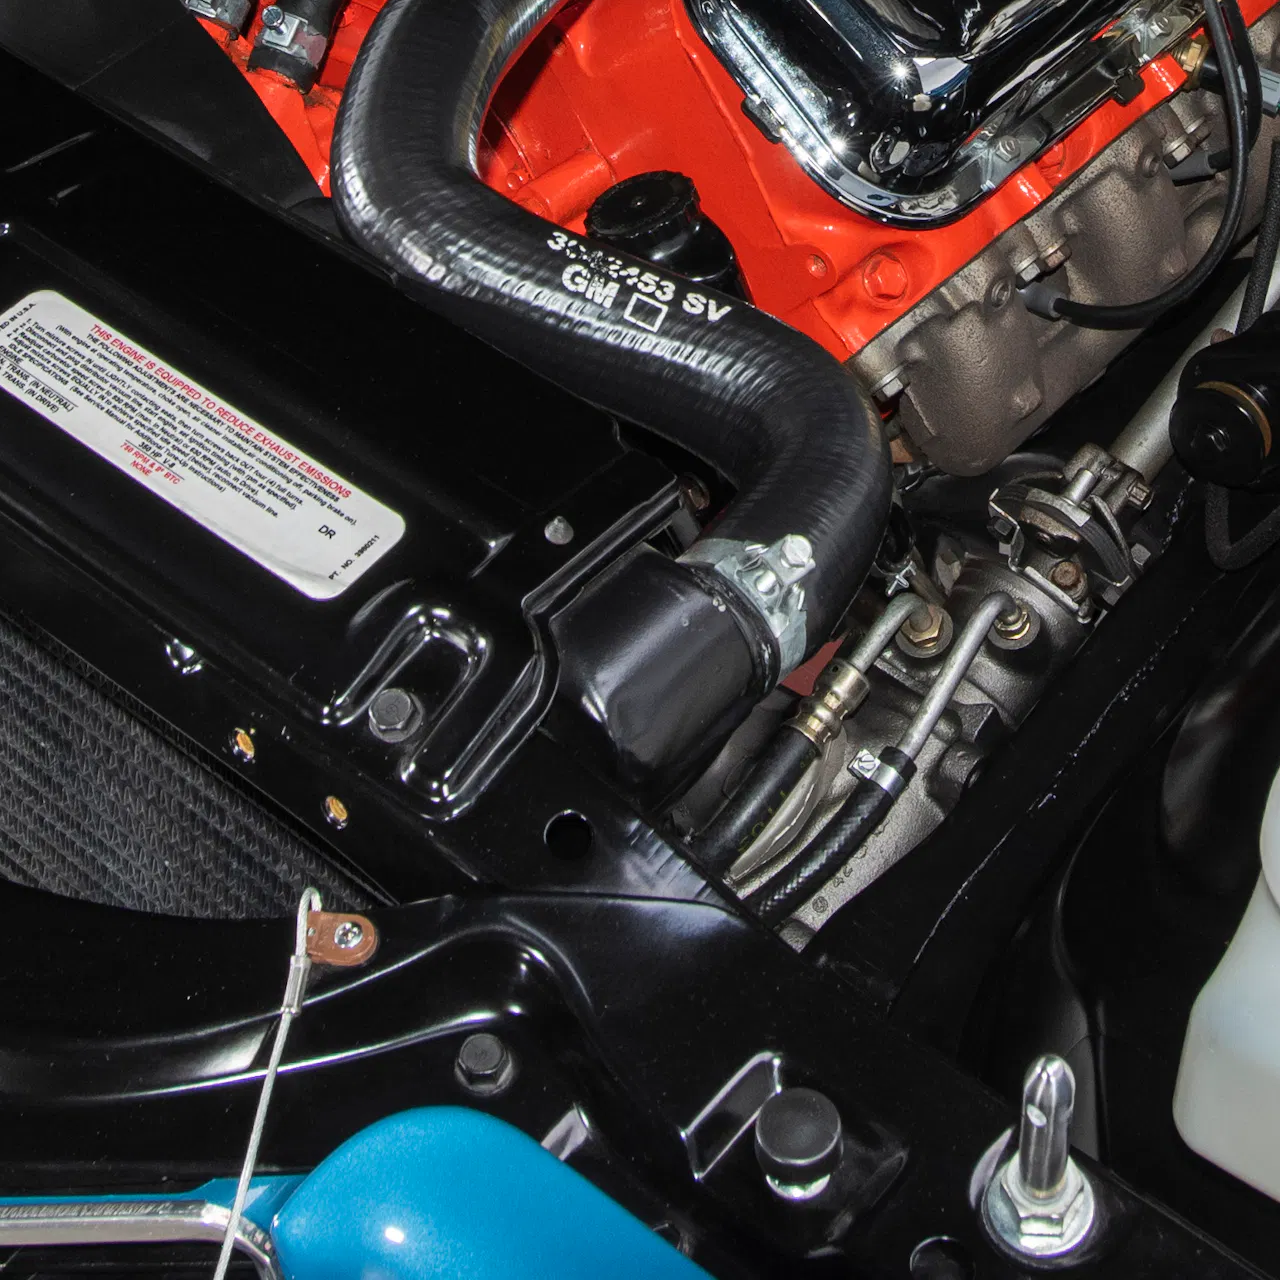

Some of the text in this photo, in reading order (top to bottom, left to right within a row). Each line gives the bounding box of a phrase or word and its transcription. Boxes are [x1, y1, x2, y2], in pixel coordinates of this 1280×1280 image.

[561, 264, 620, 309] GM
[682, 292, 732, 322] SV
[1, 371, 27, 389] TRANS.
[24, 388, 38, 397] (IN
[34, 394, 59, 413] DRIVE)
[5, 363, 31, 382] TRANS.
[28, 380, 41, 389] (IN
[38, 386, 74, 412] NEUTRAL)
[8, 343, 23, 354] IDLE
[21, 352, 69, 385] SPECIFICATIONS
[104, 409, 127, 425] Manual
[55, 325, 72, 336] (With
[71, 335, 91, 349] engine
[96, 352, 124, 371] operating
[157, 392, 176, 406] choke
[200, 420, 222, 436] cleaner
[255, 457, 293, 483] conditioning
[302, 488, 327, 505] parking
[326, 503, 344, 517] brake
[86, 333, 340, 502] THE FOLLOWING ADJUSTMENTS ARE NECESSARY TO MAINTAIN SYSTEM EFFECTIVENESS
[89, 324, 112, 341] THIS
[110, 338, 146, 363] ENGINE
[144, 360, 156, 370] IS
[154, 367, 202, 400] EQUIPPED
[200, 397, 217, 410] TO
[214, 406, 256, 435] REDUCE
[253, 432, 300, 464] EXHAUST
[298, 461, 352, 498] EMISSIONS
[130, 460, 152, 476] NONE
[132, 450, 150, 464] RPM
[163, 472, 180, 484] BTC
[138, 442, 152, 452] 350
[150, 450, 162, 458] HP
[318, 524, 336, 539] DR
